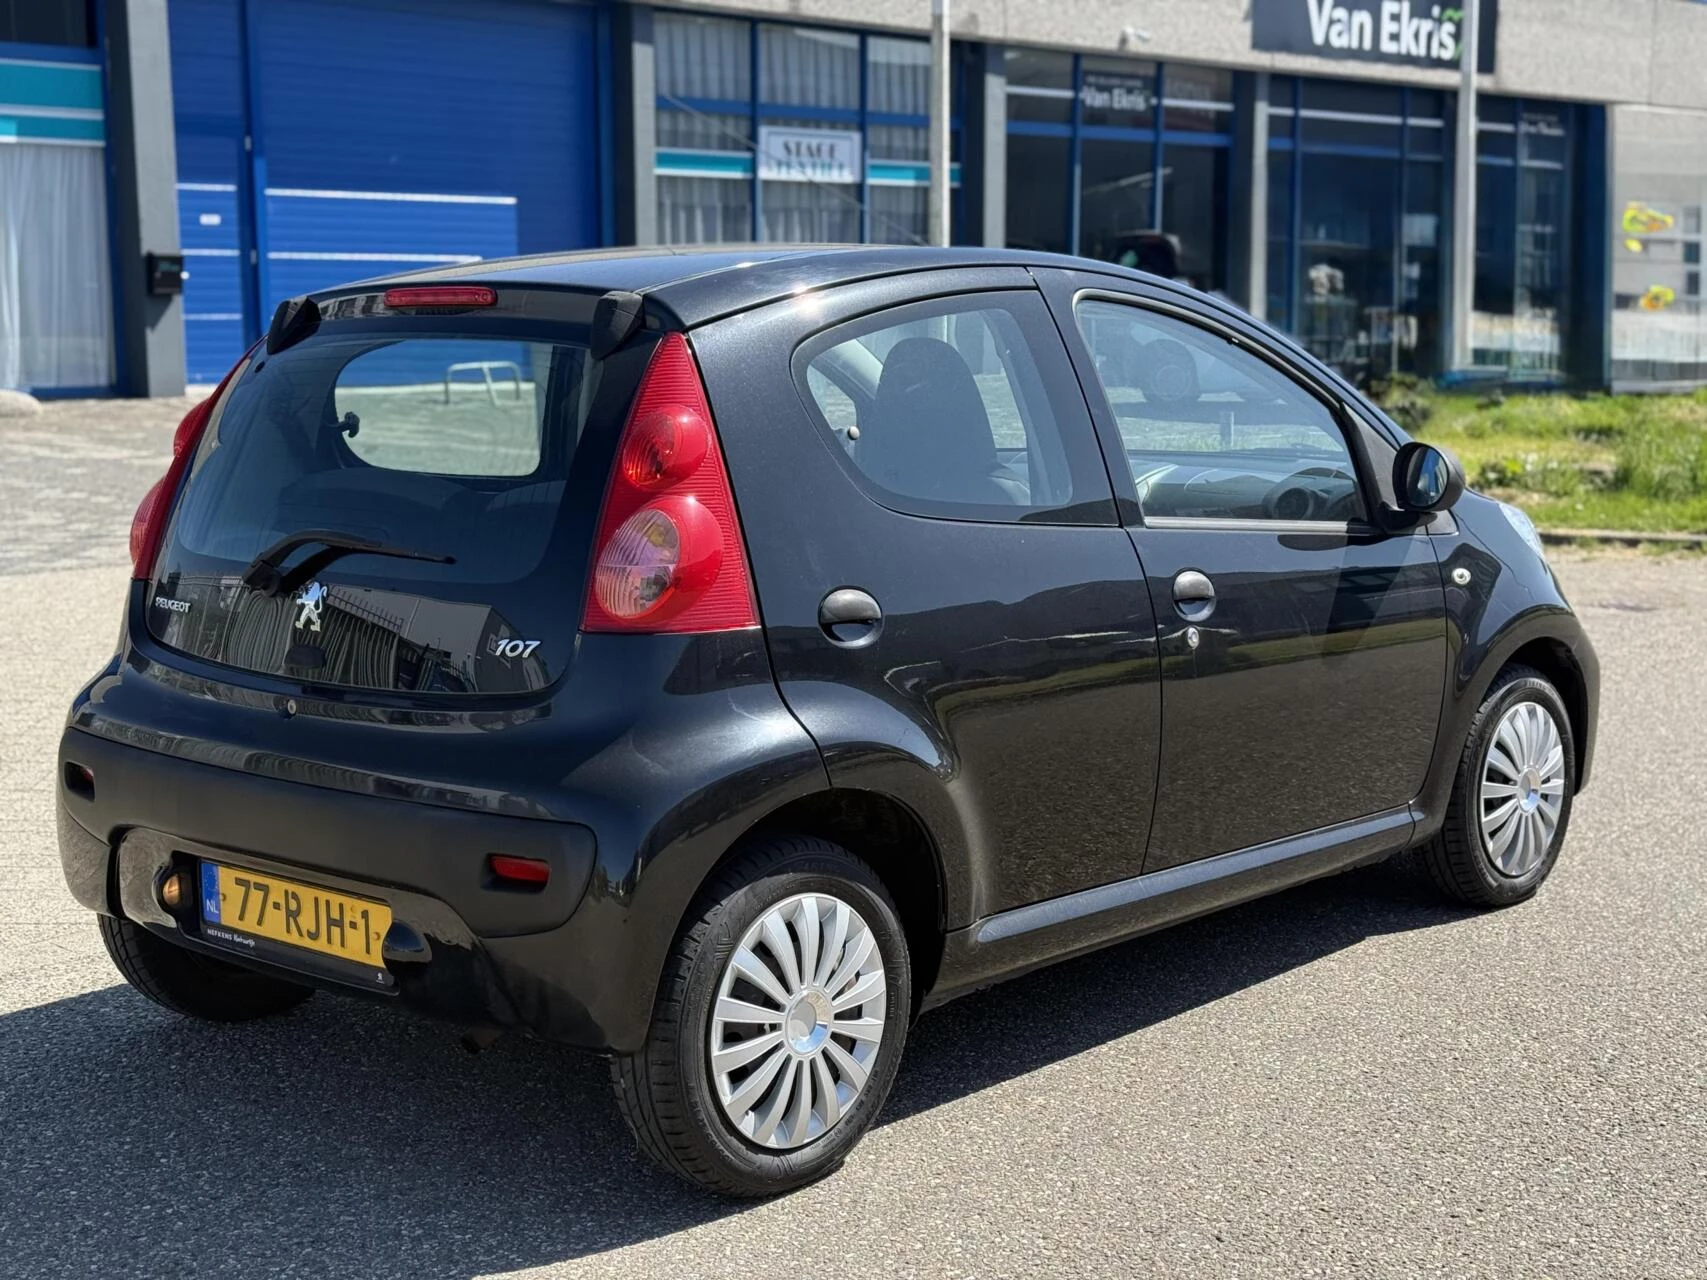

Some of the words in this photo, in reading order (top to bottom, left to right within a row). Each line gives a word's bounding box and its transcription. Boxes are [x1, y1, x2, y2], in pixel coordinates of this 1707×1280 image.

[1307, 0, 1373, 51] Van
[1380, 0, 1456, 61] Ekris
[155, 597, 191, 613] PEUGEOT
[495, 638, 541, 658] 107
[206, 899, 219, 914] NL
[234, 876, 371, 955] 77-RJH-1
